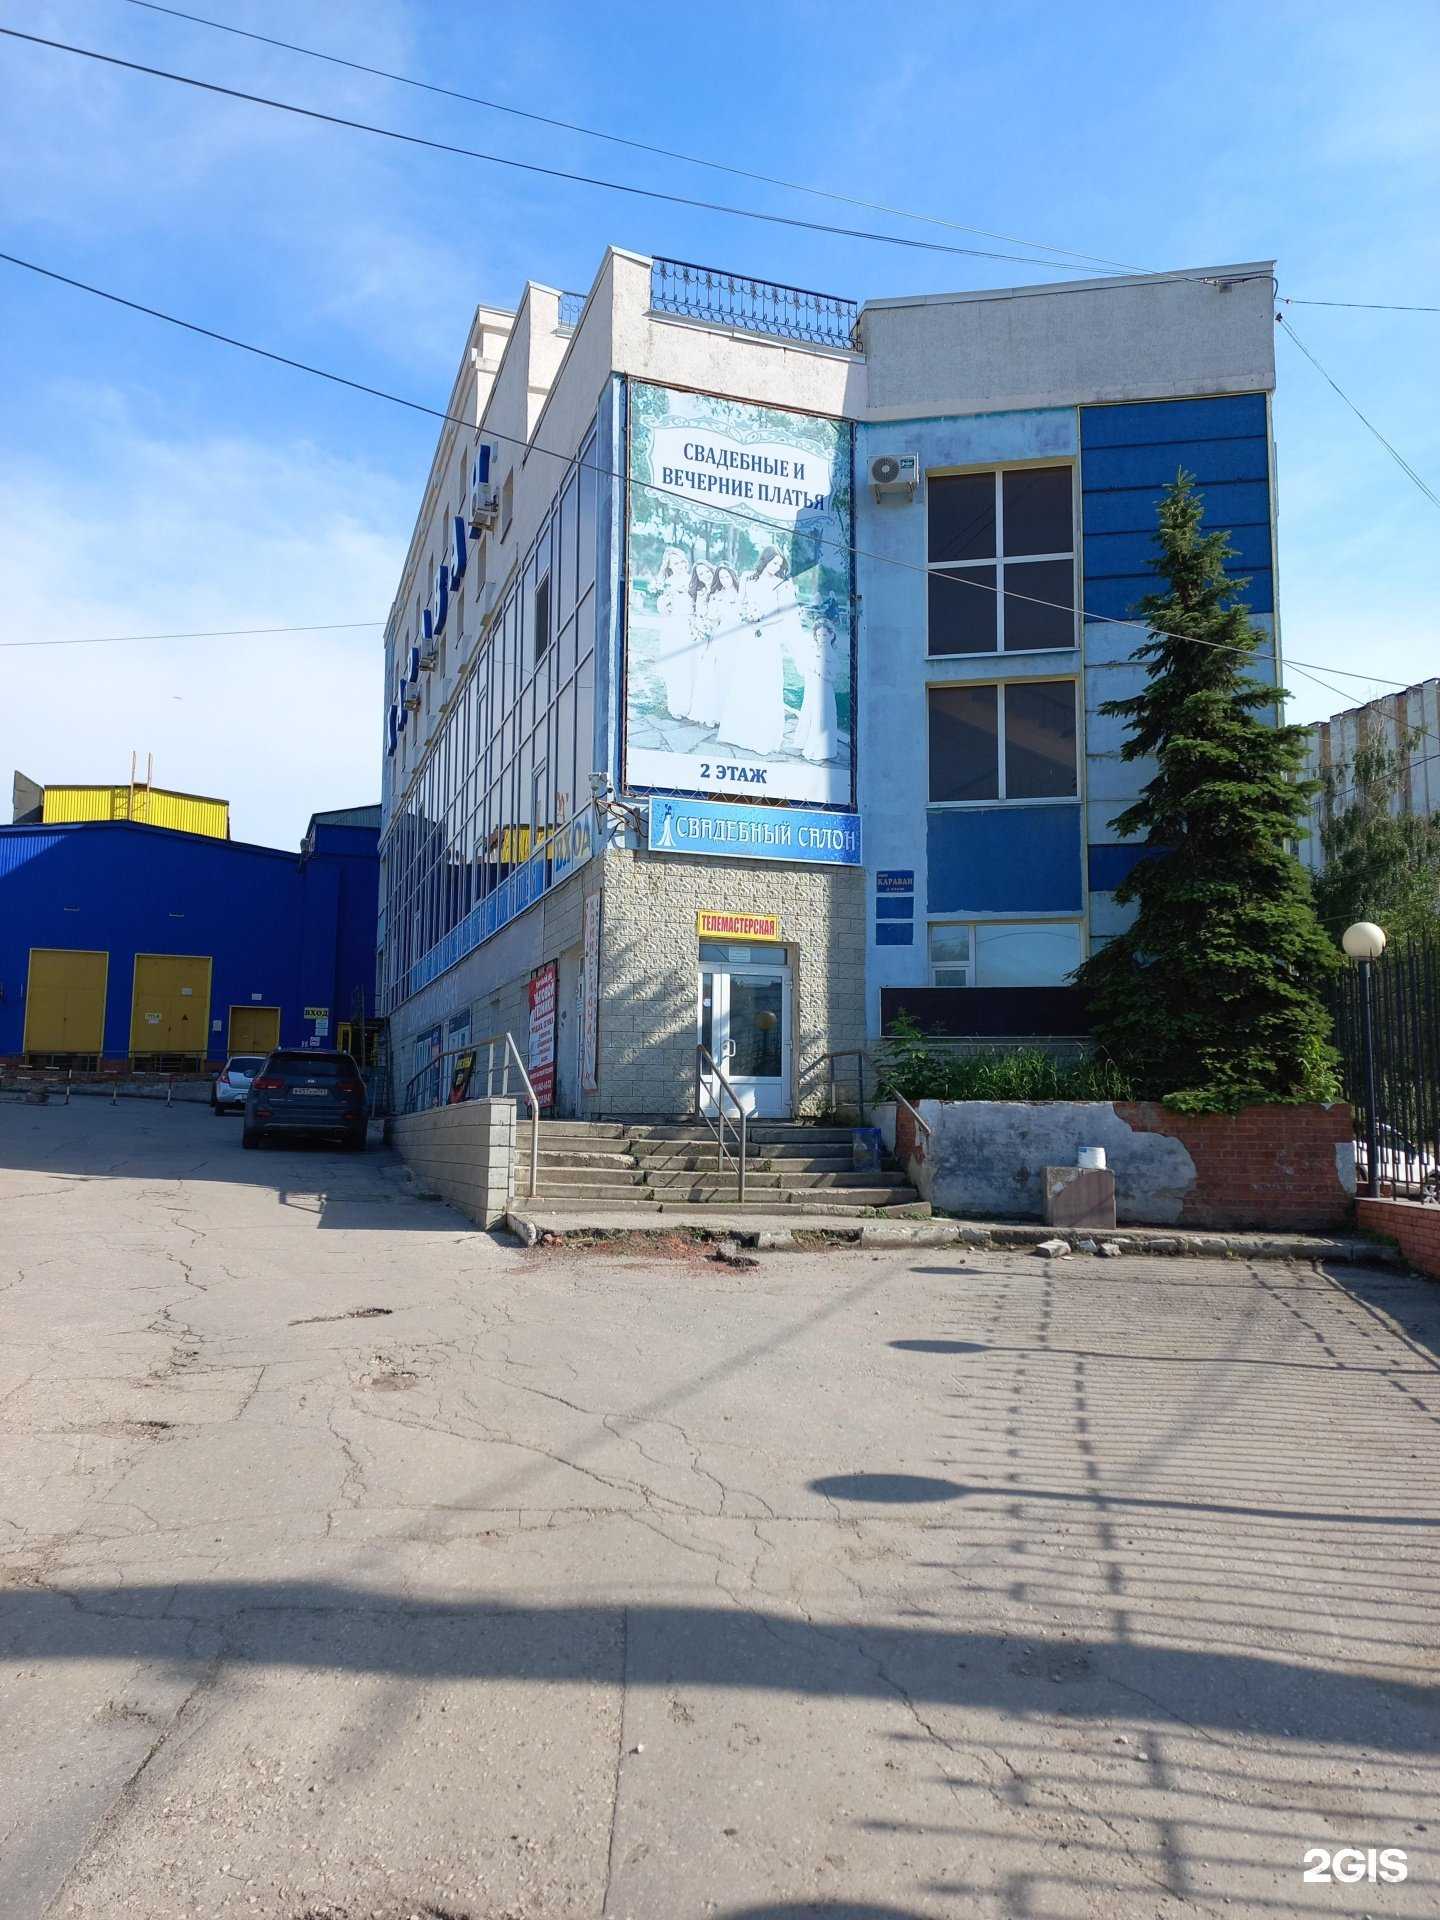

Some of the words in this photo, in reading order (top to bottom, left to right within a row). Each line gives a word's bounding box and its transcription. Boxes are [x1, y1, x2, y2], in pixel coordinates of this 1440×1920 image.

[684, 443, 788, 477] СВАДЕБНЫЕ
[794, 462, 805, 480] И
[662, 467, 753, 499] ВЕЧЕРНИЕ
[759, 484, 824, 511] ПЛАТЬЯ
[700, 763, 711, 778] 2
[716, 765, 767, 784] ЭТАЖ
[676, 816, 791, 846] СВАДЕБНЫЙ
[798, 826, 856, 851] САЛОН
[701, 914, 775, 935] ТЕЛЕМАСТЕРСКАЯ
[304, 1009, 328, 1017] ВХОД
